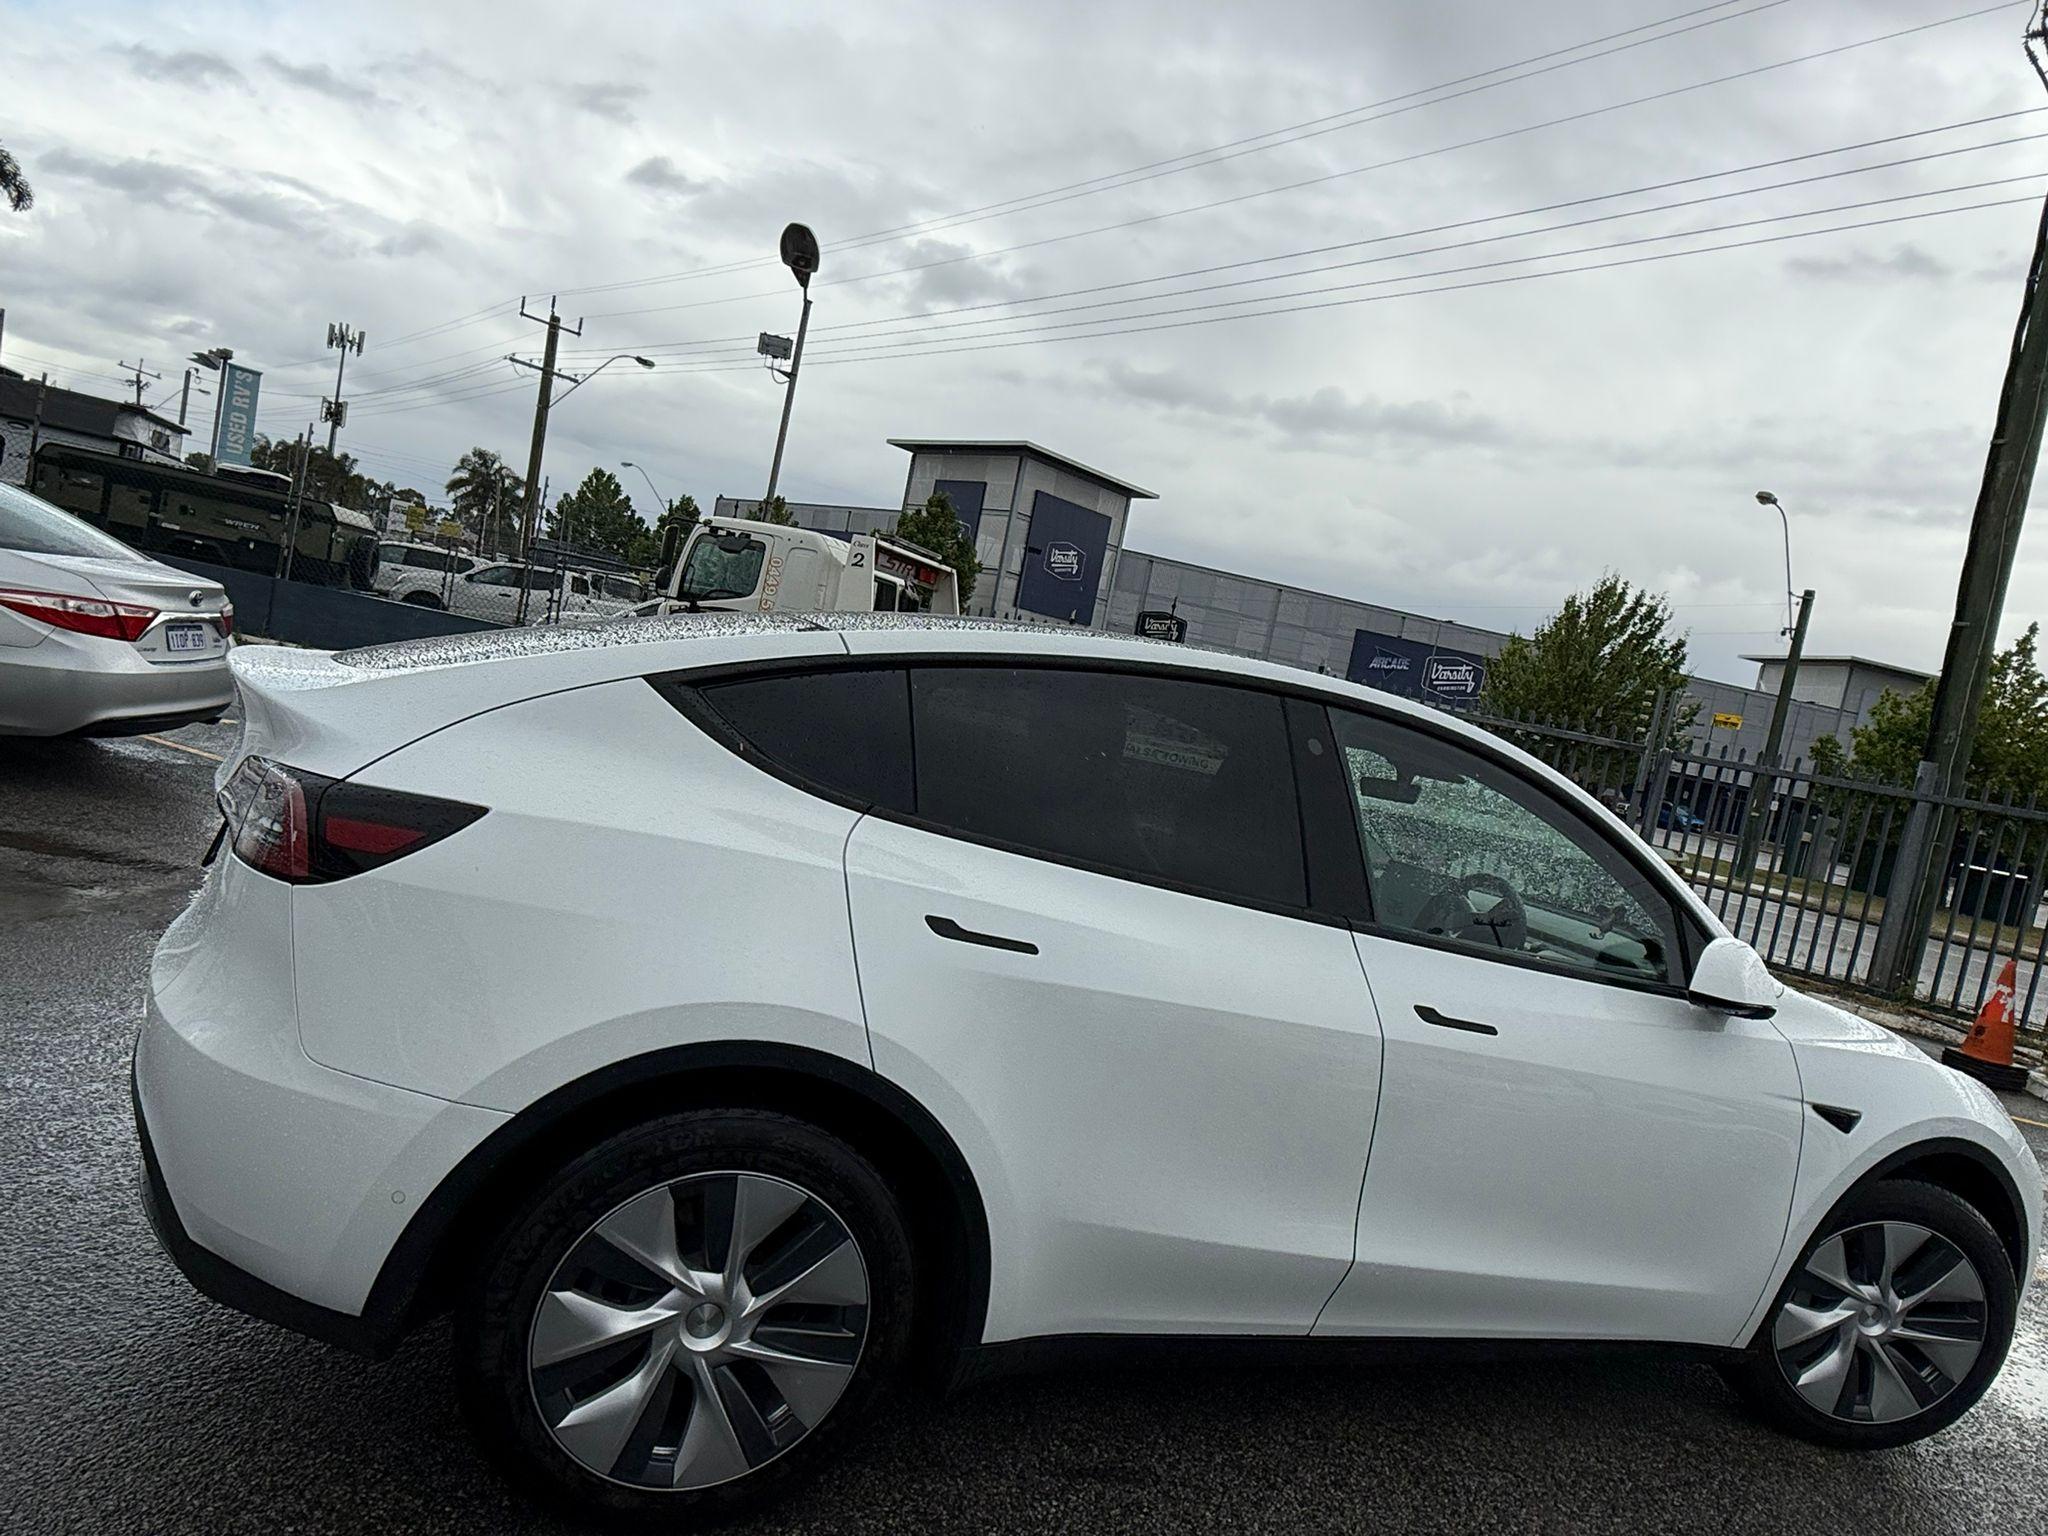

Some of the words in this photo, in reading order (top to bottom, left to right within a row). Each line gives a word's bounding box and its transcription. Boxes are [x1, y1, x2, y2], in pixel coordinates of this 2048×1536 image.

[232, 371, 253, 409] RV'S
[225, 412, 247, 454] USED
[224, 518, 261, 530] WREN
[851, 552, 865, 567] 2
[763, 557, 783, 595] 0449
[1369, 656, 1411, 670] ARCADE
[1431, 662, 1475, 693] Varsity
